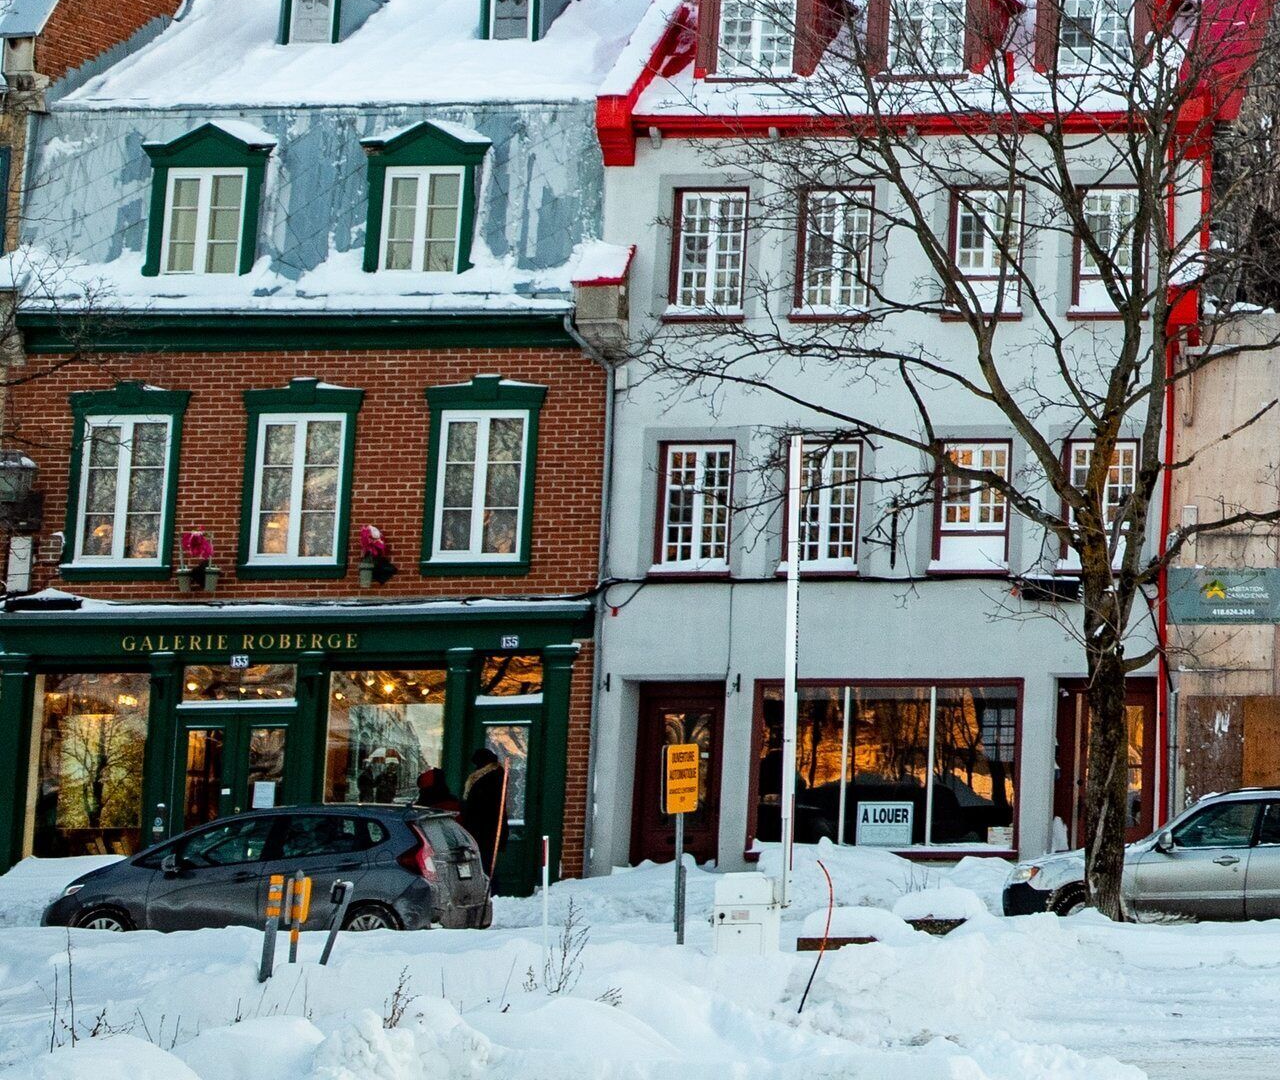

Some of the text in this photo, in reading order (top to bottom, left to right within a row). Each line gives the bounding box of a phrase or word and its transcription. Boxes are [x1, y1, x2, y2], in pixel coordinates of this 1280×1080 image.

[122, 633, 358, 651] GALERIE ROBERGE
[232, 655, 248, 667] 133
[873, 808, 909, 824] LOUER
